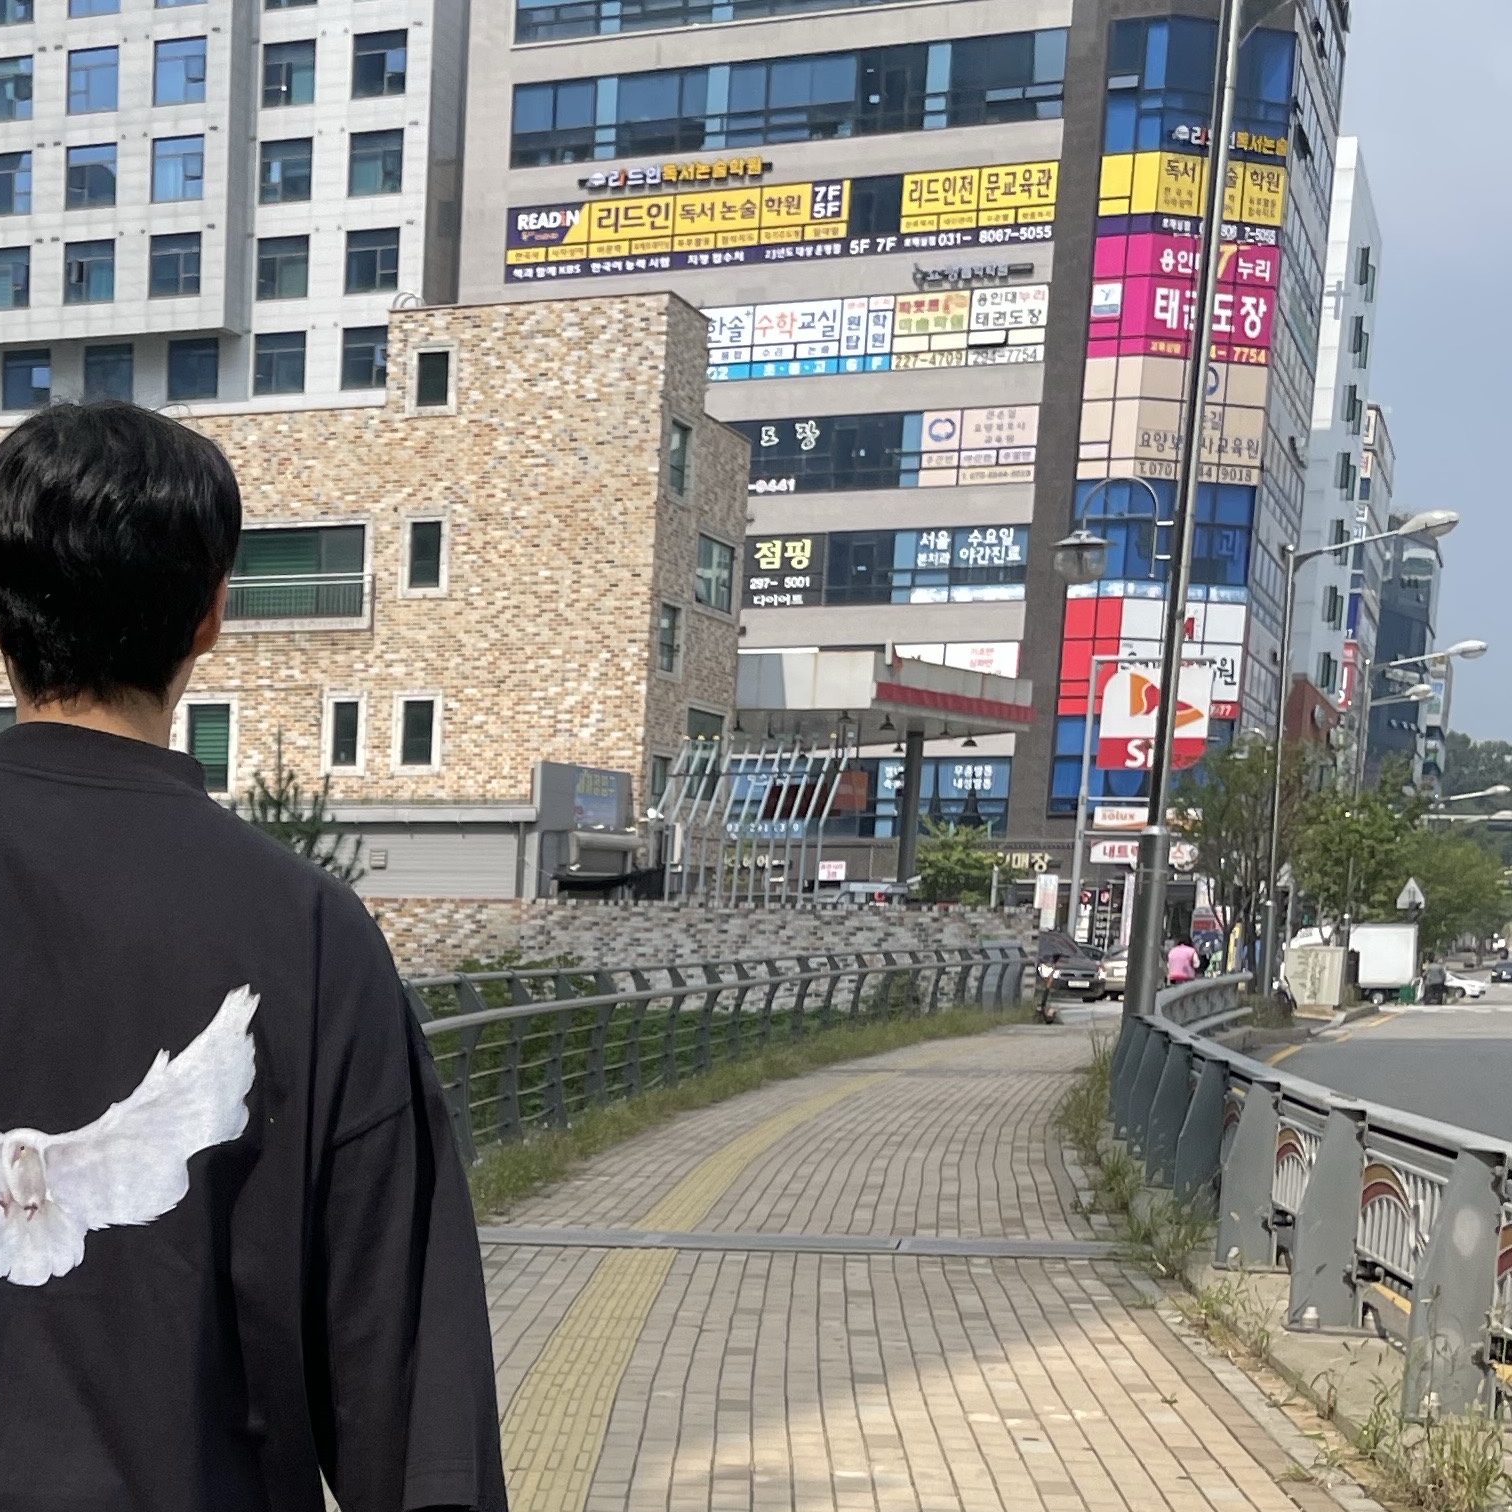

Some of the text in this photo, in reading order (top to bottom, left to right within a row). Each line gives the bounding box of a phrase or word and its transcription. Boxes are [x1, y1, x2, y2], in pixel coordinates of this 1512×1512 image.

[1165, 159, 1197, 183] 독서
[1250, 169, 1281, 194] 학원
[813, 185, 841, 202] 7F
[597, 194, 802, 234] 리드인 독서 논술 학원
[812, 201, 841, 219] 5F
[849, 238, 871, 256] 5F
[876, 235, 897, 252] 7F
[1238, 257, 1271, 282] 누리
[1233, 346, 1266, 364] 7754
[920, 530, 951, 550] 서울
[968, 528, 1015, 546] 수요일
[753, 538, 813, 570] 점핑
[959, 544, 1022, 565] 야간진료
[753, 593, 804, 607] 다이어트
